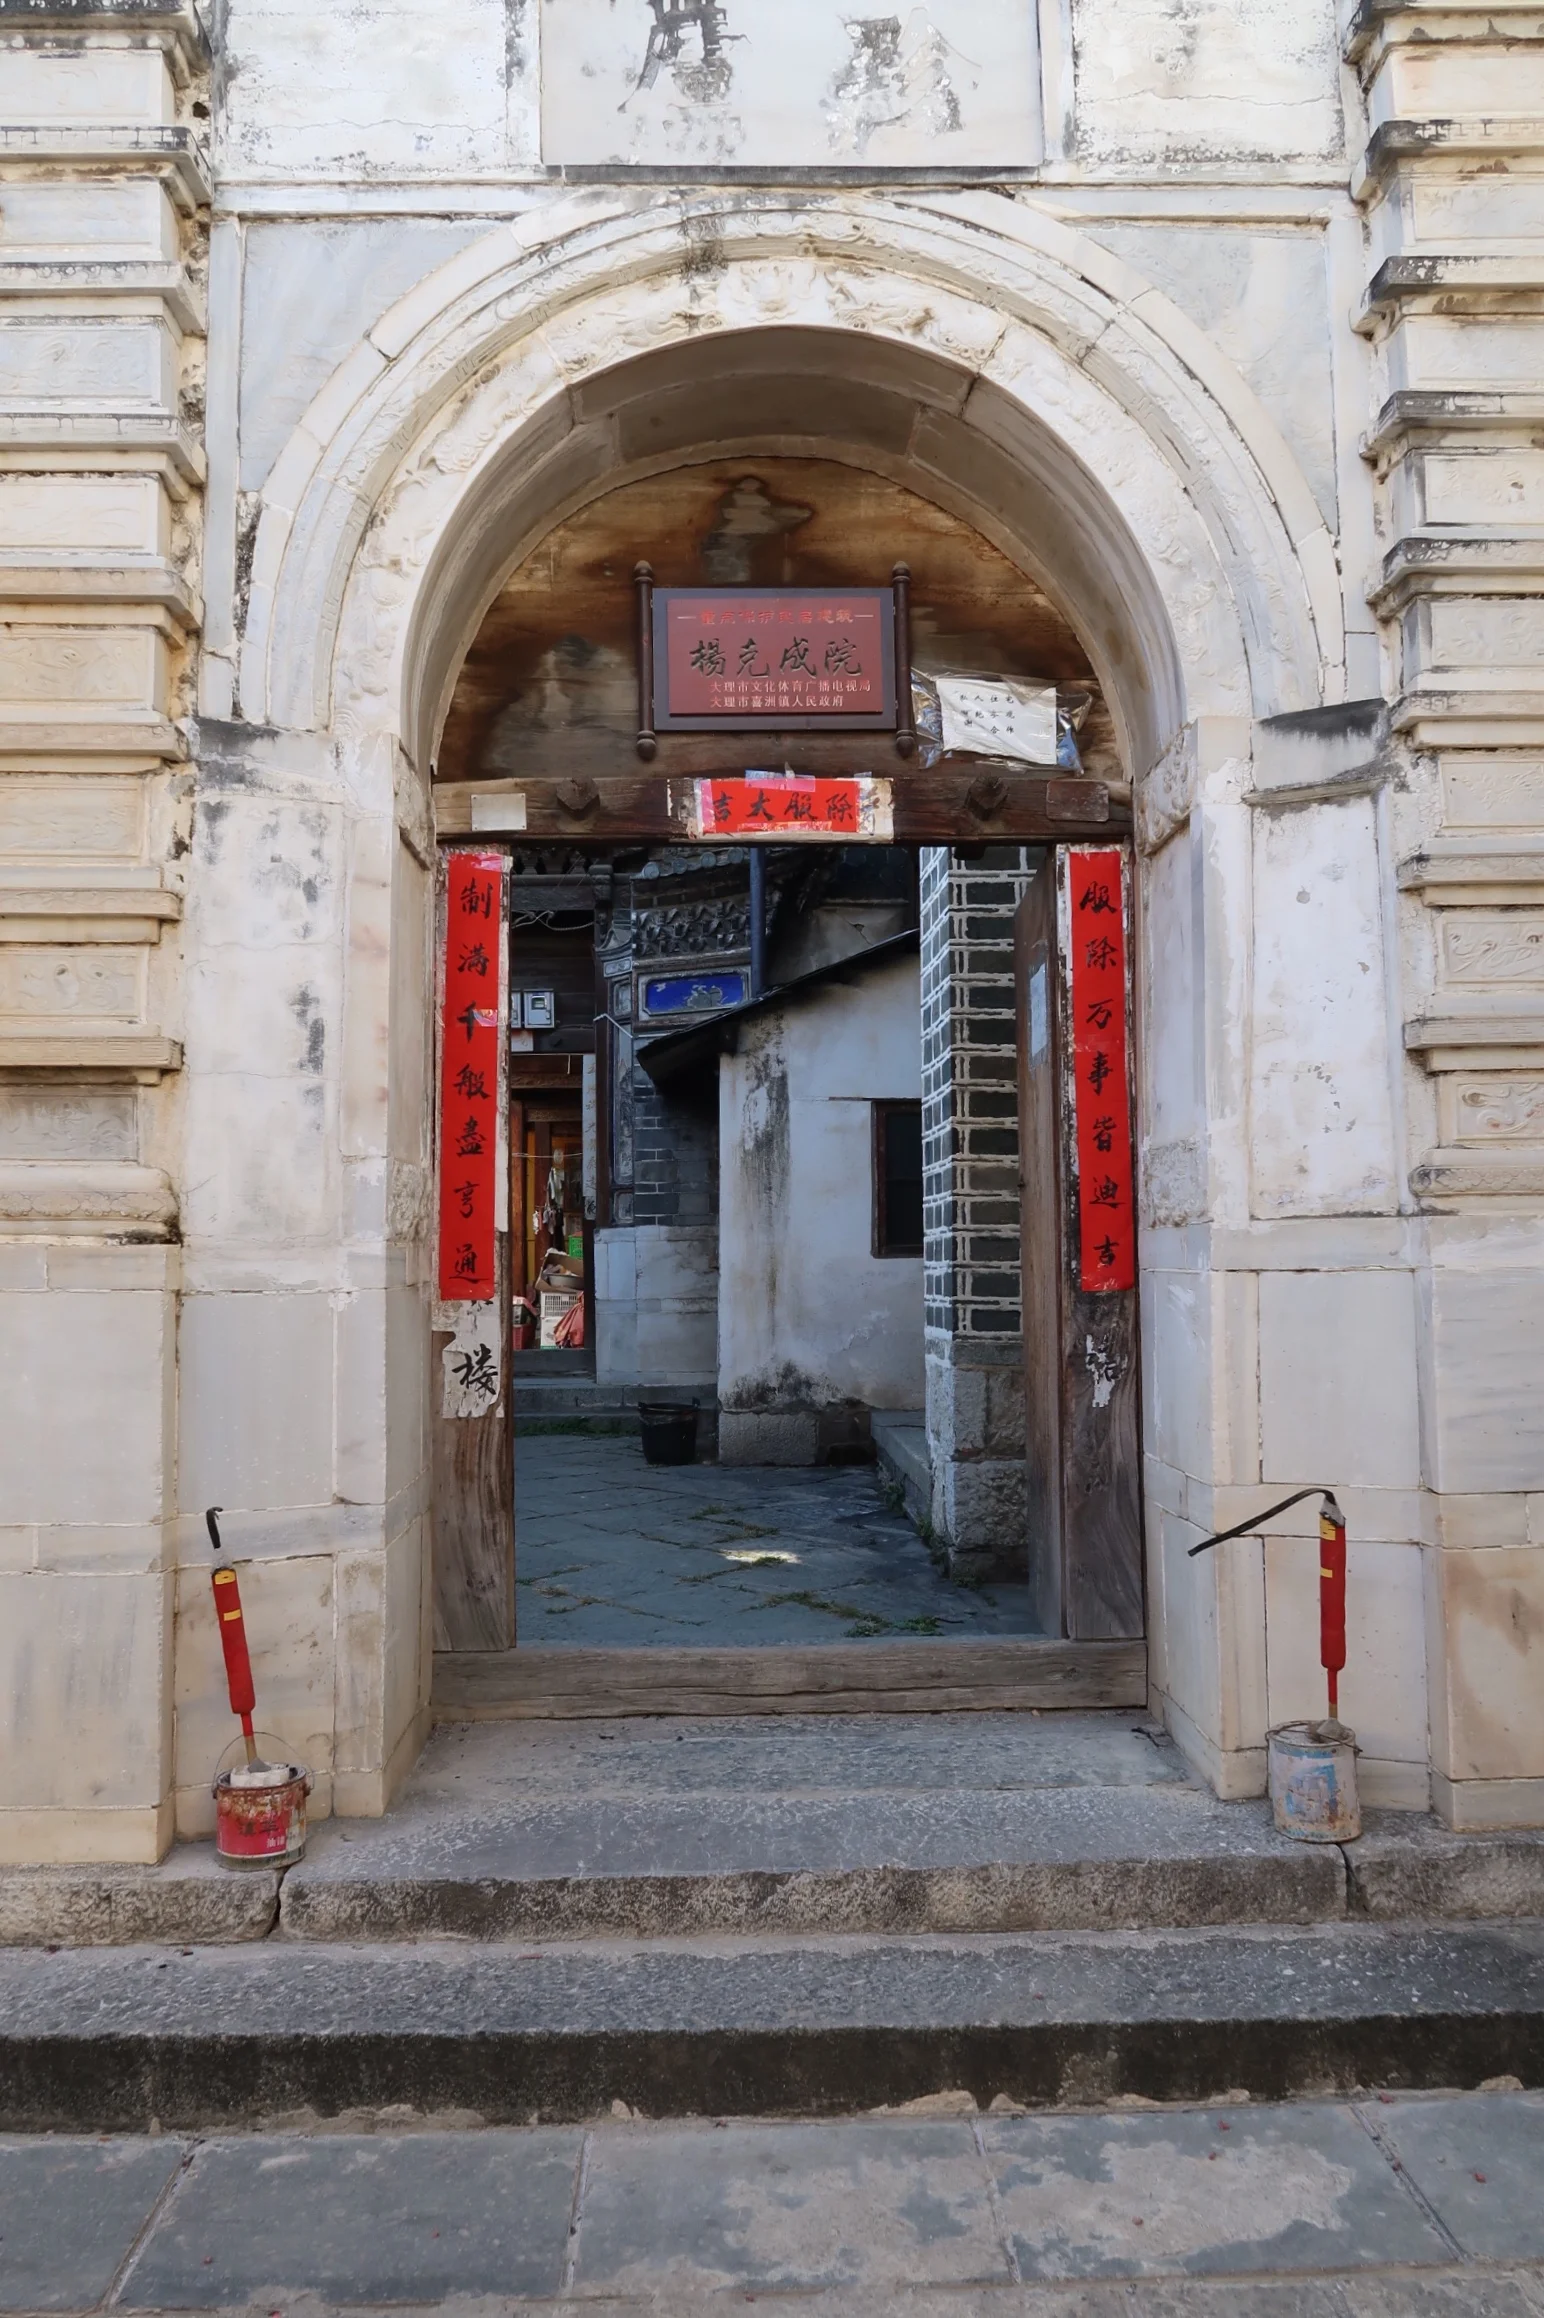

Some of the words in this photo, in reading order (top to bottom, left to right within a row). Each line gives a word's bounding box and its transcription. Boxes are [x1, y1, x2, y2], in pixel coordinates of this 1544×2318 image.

[710, 679, 871, 693] 大理市文化体育广播电视局
[710, 694, 844, 708] 大理市喜洲镇人民政府
